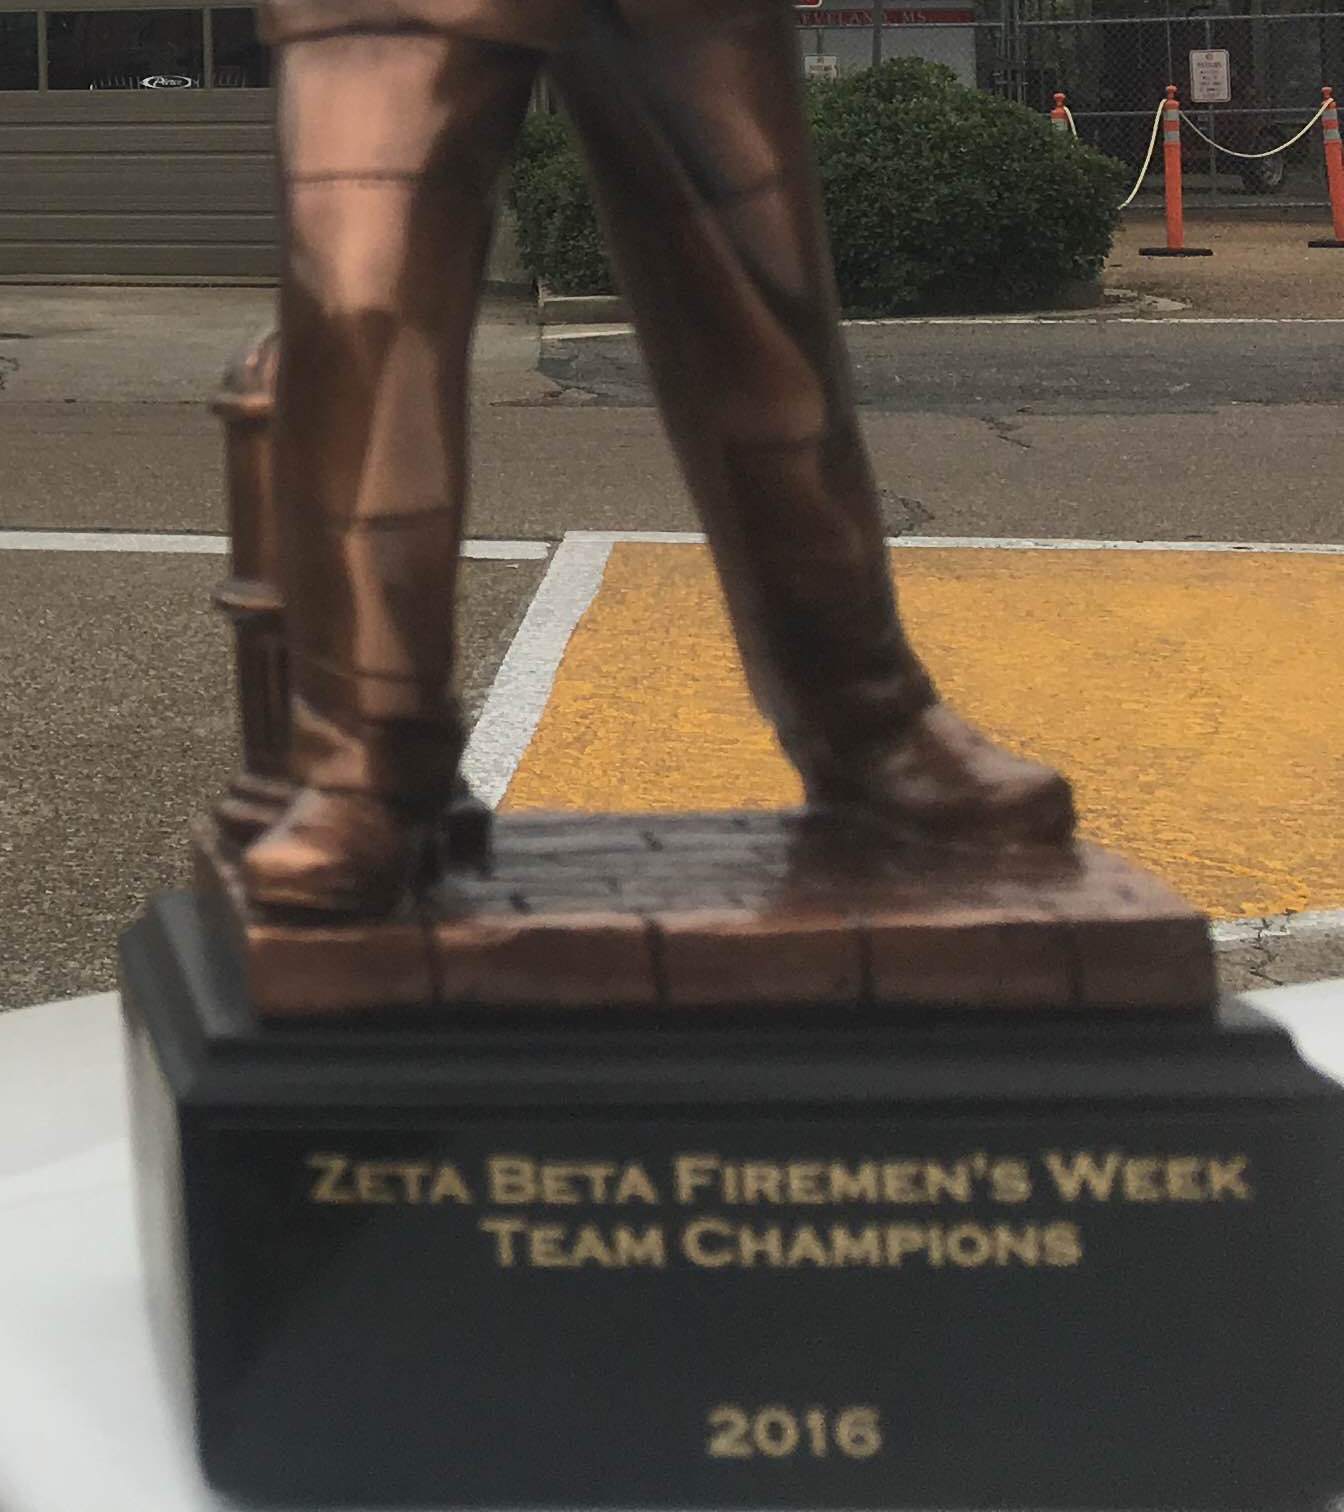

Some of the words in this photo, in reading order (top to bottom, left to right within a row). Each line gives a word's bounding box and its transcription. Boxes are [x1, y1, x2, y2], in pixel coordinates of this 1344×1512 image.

[310, 1152, 472, 1205] ZETA
[488, 1153, 658, 1205] BETA
[674, 1151, 1032, 1205] FIREMEN'S
[1044, 1150, 1251, 1203] WEEK
[479, 1215, 666, 1268] TEAM
[681, 1216, 1084, 1268] CHAMPIONS
[708, 1405, 882, 1459] 2016
